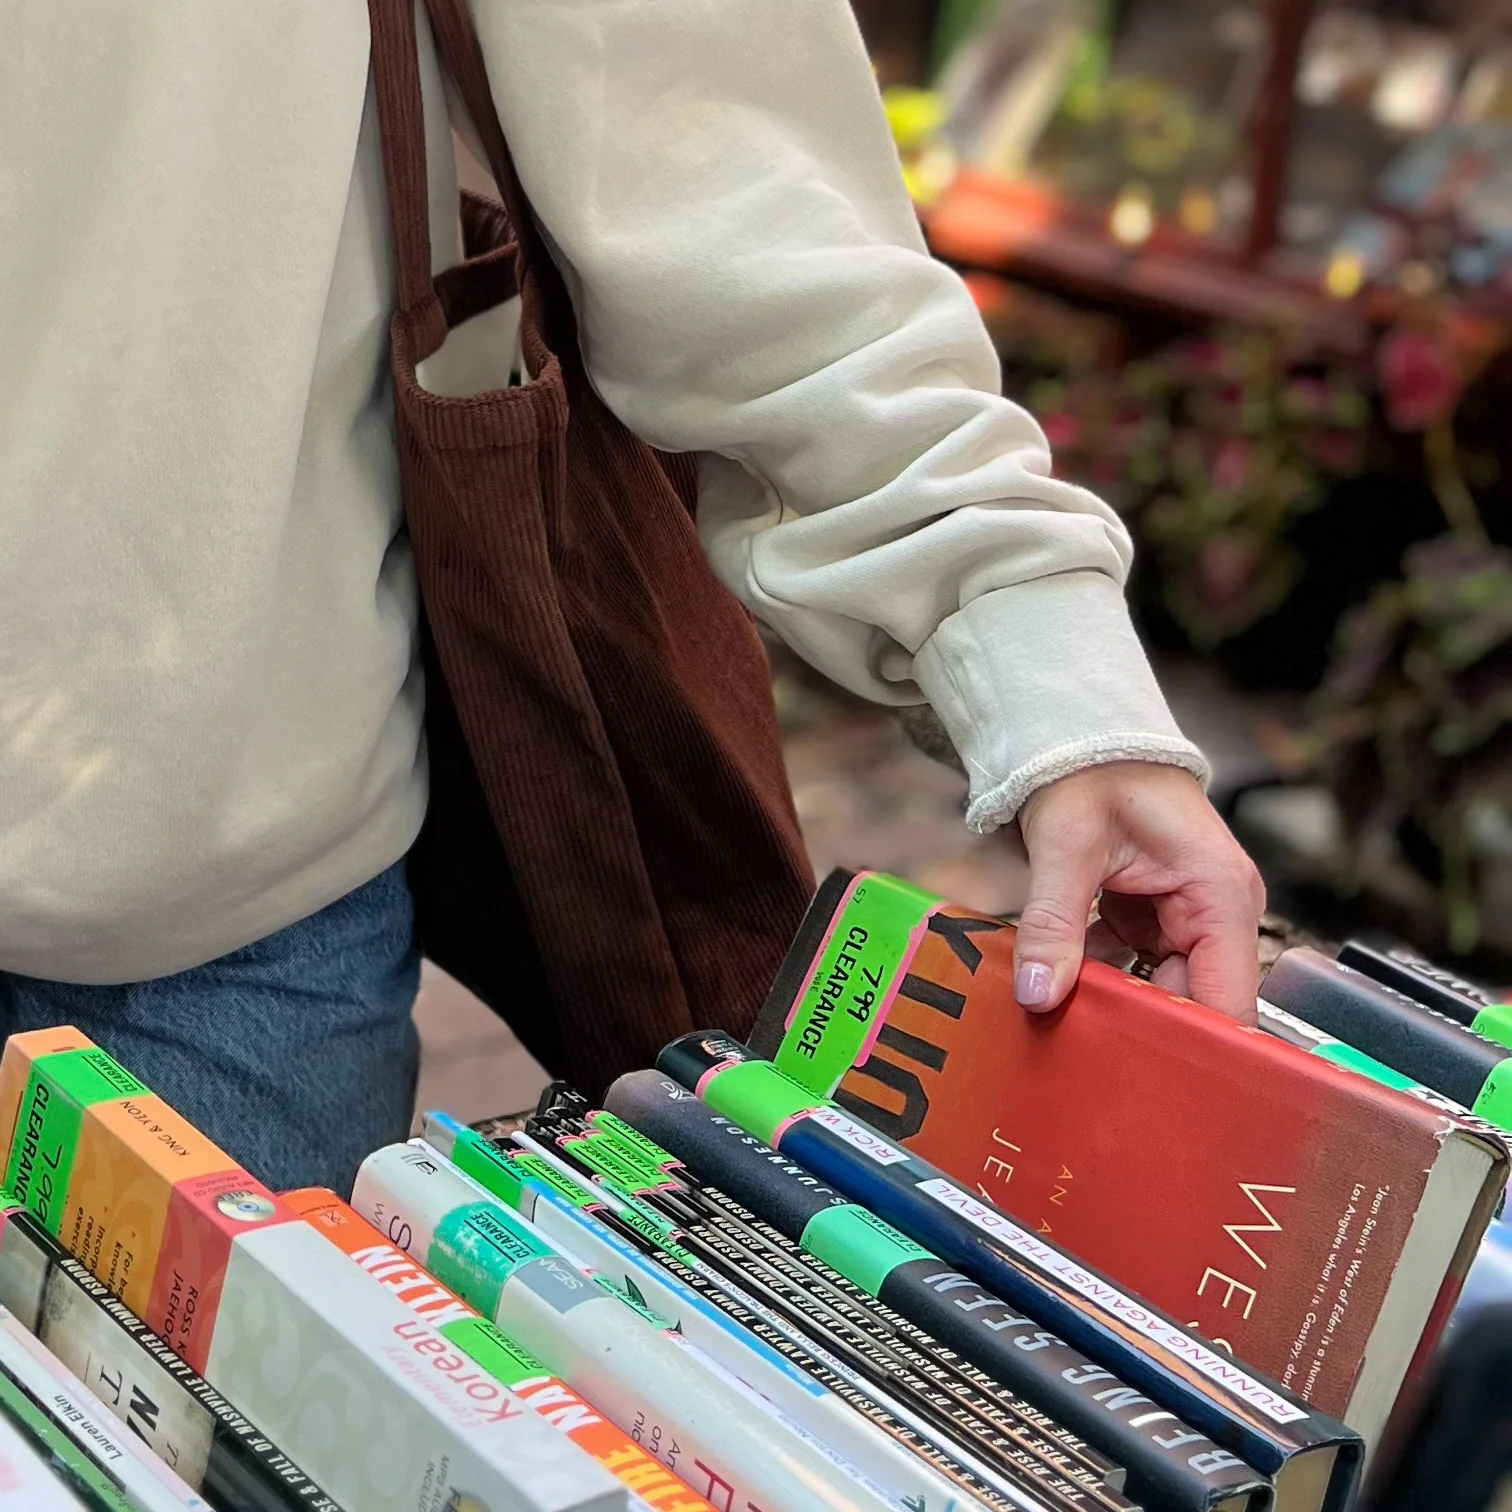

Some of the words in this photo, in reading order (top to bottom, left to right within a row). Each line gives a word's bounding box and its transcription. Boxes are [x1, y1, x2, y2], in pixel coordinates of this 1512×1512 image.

[796, 926, 869, 1060] CLEARANCE
[846, 964, 884, 1024] 7.99
[87, 1052, 139, 1093] CLEARANCE
[120, 1099, 153, 1128] YEON
[148, 1124, 164, 1134] &
[158, 1133, 191, 1158] KING
[609, 1115, 667, 1156] CLEARANCE
[842, 1126, 898, 1162] RICK
[579, 1143, 641, 1185] CLEARANCE
[603, 1136, 662, 1178] CLEARANCE
[709, 1115, 850, 1207] SJUNNESON
[529, 1156, 591, 1198] CLEARANCE
[1349, 1182, 1366, 1203] Los
[701, 1186, 756, 1222] OSBORN
[937, 1183, 1003, 1228] DEVIL
[469, 1212, 532, 1260] CLEARANCE
[626, 1213, 689, 1258] CLEARANCE
[688, 1224, 745, 1261] OSBORN
[709, 1215, 766, 1251] OSBORN
[751, 1219, 802, 1254] TOMMY
[855, 1208, 923, 1253] CLEARANCE
[1001, 1228, 1051, 1261] THE
[1333, 1202, 1357, 1251] Angeles
[59, 1257, 109, 1297] OSBORN
[122, 1250, 135, 1276] For
[651, 1251, 709, 1288] OSBORN
[739, 1260, 792, 1297] TOMMY
[760, 1250, 815, 1285] TOMMY
[799, 1252, 859, 1294] LAWYER
[1320, 1250, 1337, 1283] what
[1345, 1258, 1363, 1290] West
[349, 1244, 479, 1329] KLEIN
[1054, 1265, 1168, 1333] AGAINST
[1316, 1283, 1328, 1294] it
[1338, 1288, 1350, 1306] of
[99, 1291, 147, 1334] TOMMY
[180, 1284, 199, 1337] ROSS
[704, 1286, 757, 1324] TOMMY
[788, 1294, 850, 1342] LAWYER
[809, 1284, 872, 1329] LAWYER
[854, 1292, 936, 1346] NASHVILLE
[922, 1272, 1069, 1353] SEEN
[1325, 1302, 1346, 1334] Eden
[479, 1321, 545, 1372] CLEARANCE
[754, 1320, 815, 1366] LAWYER
[931, 1345, 957, 1361] OF
[1289, 1311, 1318, 1360] Gossipy,
[1316, 1347, 1326, 1359] a
[1322, 1334, 1331, 1347] is
[138, 1332, 194, 1377] LAWYER
[392, 1319, 524, 1424] Korean
[844, 1337, 930, 1391] NASHVILLE
[866, 1326, 950, 1382] NASHVILLE
[945, 1380, 972, 1396] OF
[959, 1361, 1000, 1389] FALL
[996, 1388, 1014, 1398] &
[1168, 1334, 1296, 1418] RUNNING
[53, 1393, 85, 1423] Elkin
[183, 1376, 256, 1439] NASHVILLE
[809, 1365, 895, 1427] NASHVILLE
[925, 1390, 953, 1407] OF
[972, 1396, 1016, 1427] FALL
[1010, 1399, 1055, 1427] RISE
[891, 1425, 918, 1440] OF
[951, 1406, 995, 1437] FALL
[1011, 1425, 1031, 1436] &
[1061, 1364, 1247, 1475] BEING
[81, 1420, 124, 1462] Lauren
[245, 1437, 273, 1453] OF
[916, 1440, 960, 1471] FALL
[991, 1436, 1011, 1447] &
[1026, 1435, 1073, 1466] RISE
[1050, 1427, 1088, 1452] THE
[268, 1452, 308, 1485] FALL
[957, 1471, 976, 1484] &
[1006, 1448, 1052, 1477] RISE
[1068, 1463, 1107, 1491] THE
[1047, 1476, 1087, 1502] THE
